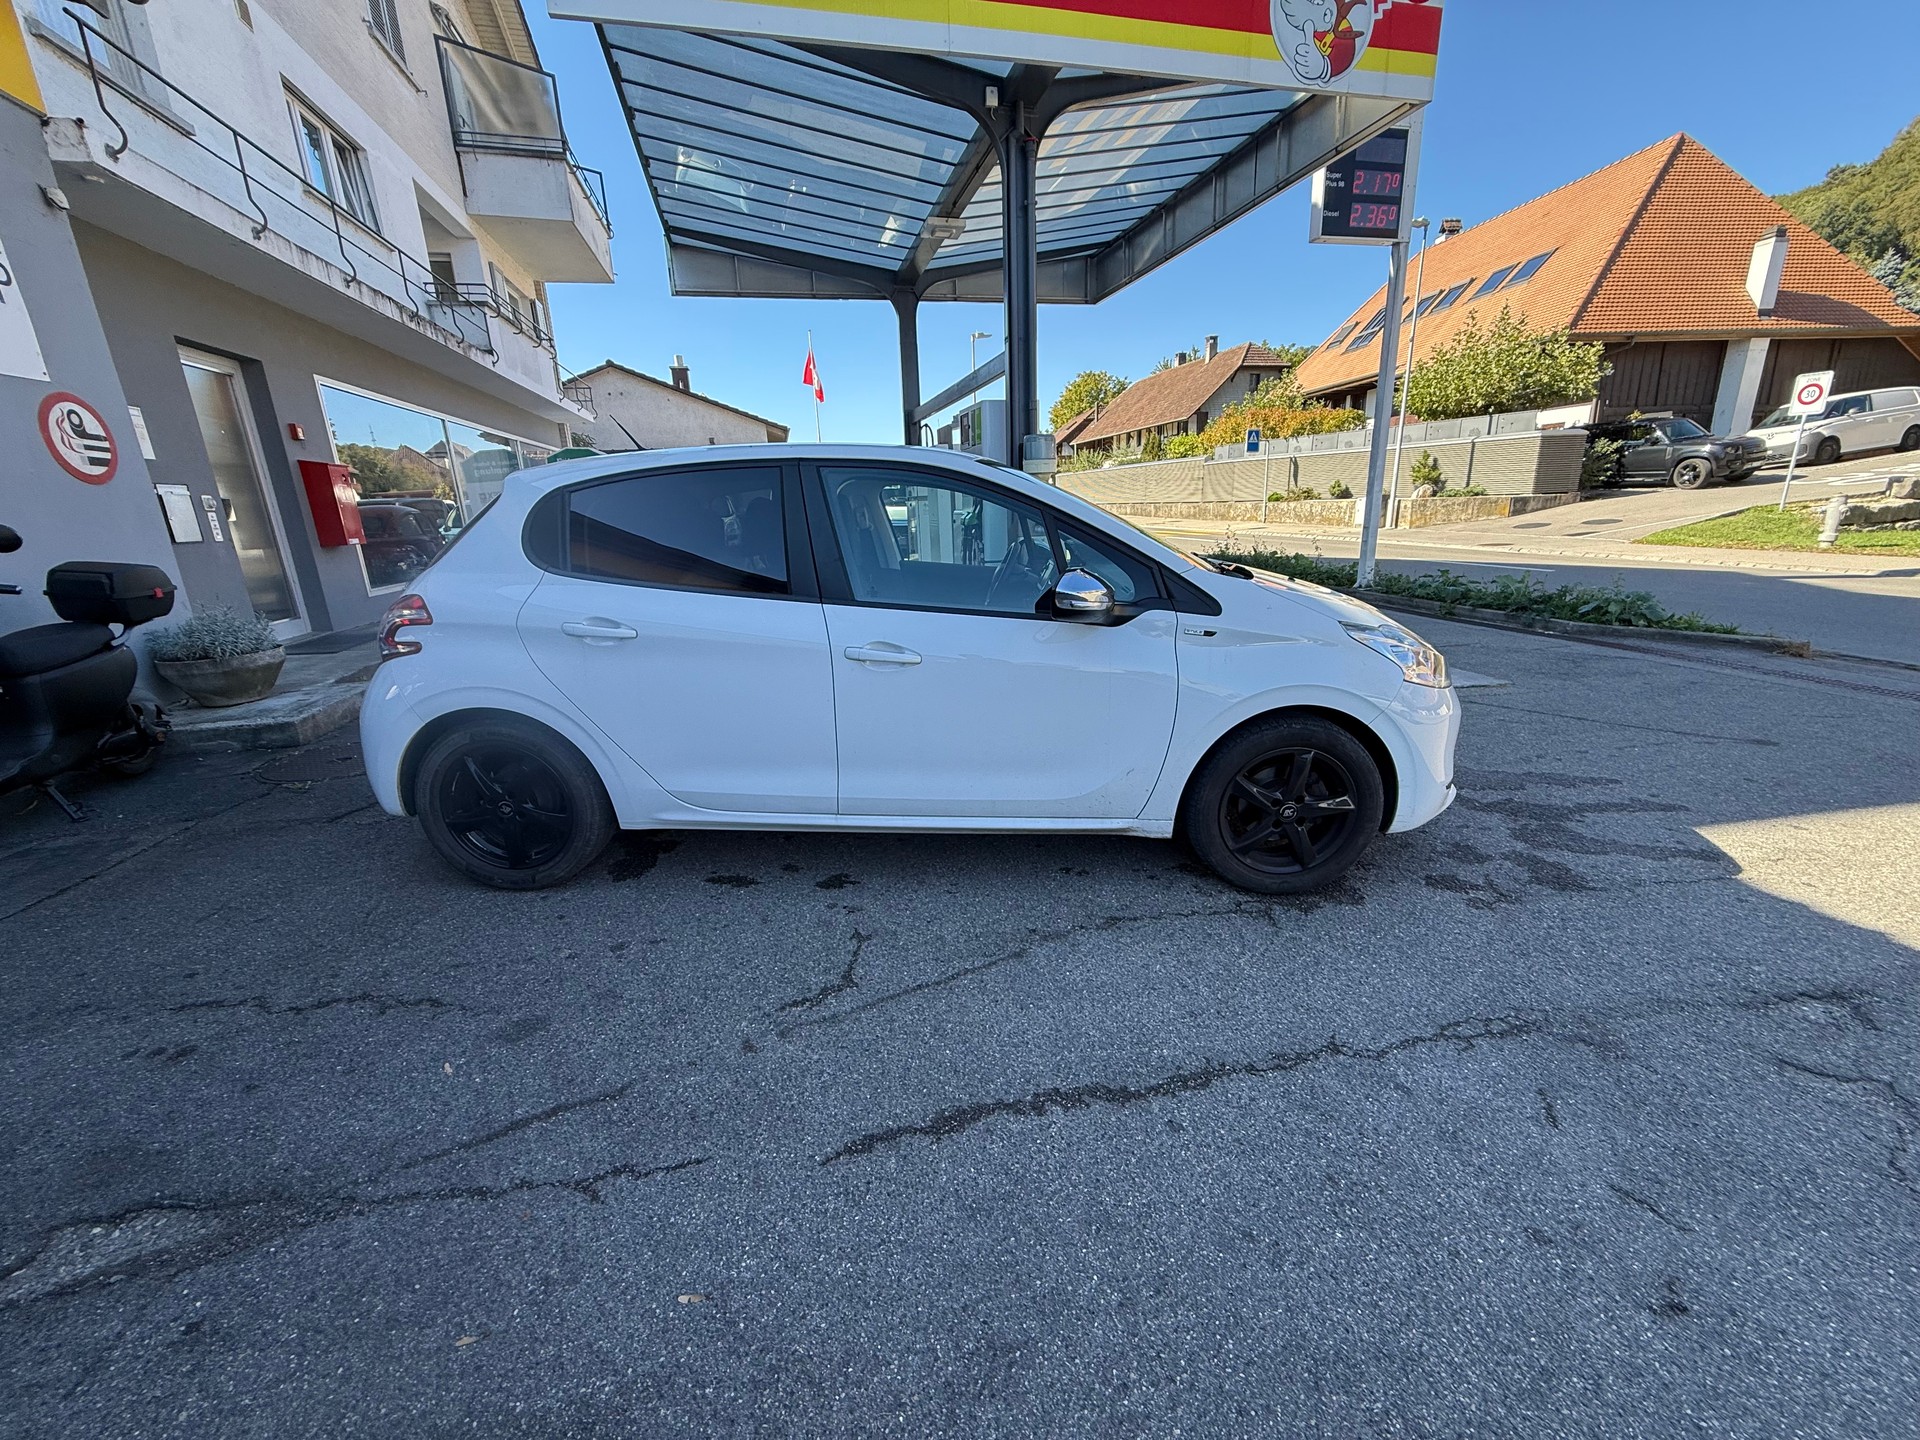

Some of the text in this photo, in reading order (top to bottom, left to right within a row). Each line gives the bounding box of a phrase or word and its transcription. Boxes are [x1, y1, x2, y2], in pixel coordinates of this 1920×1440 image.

[1326, 171, 1342, 179] Super
[1326, 180, 1337, 188] Plus
[1804, 389, 1816, 399] 30
